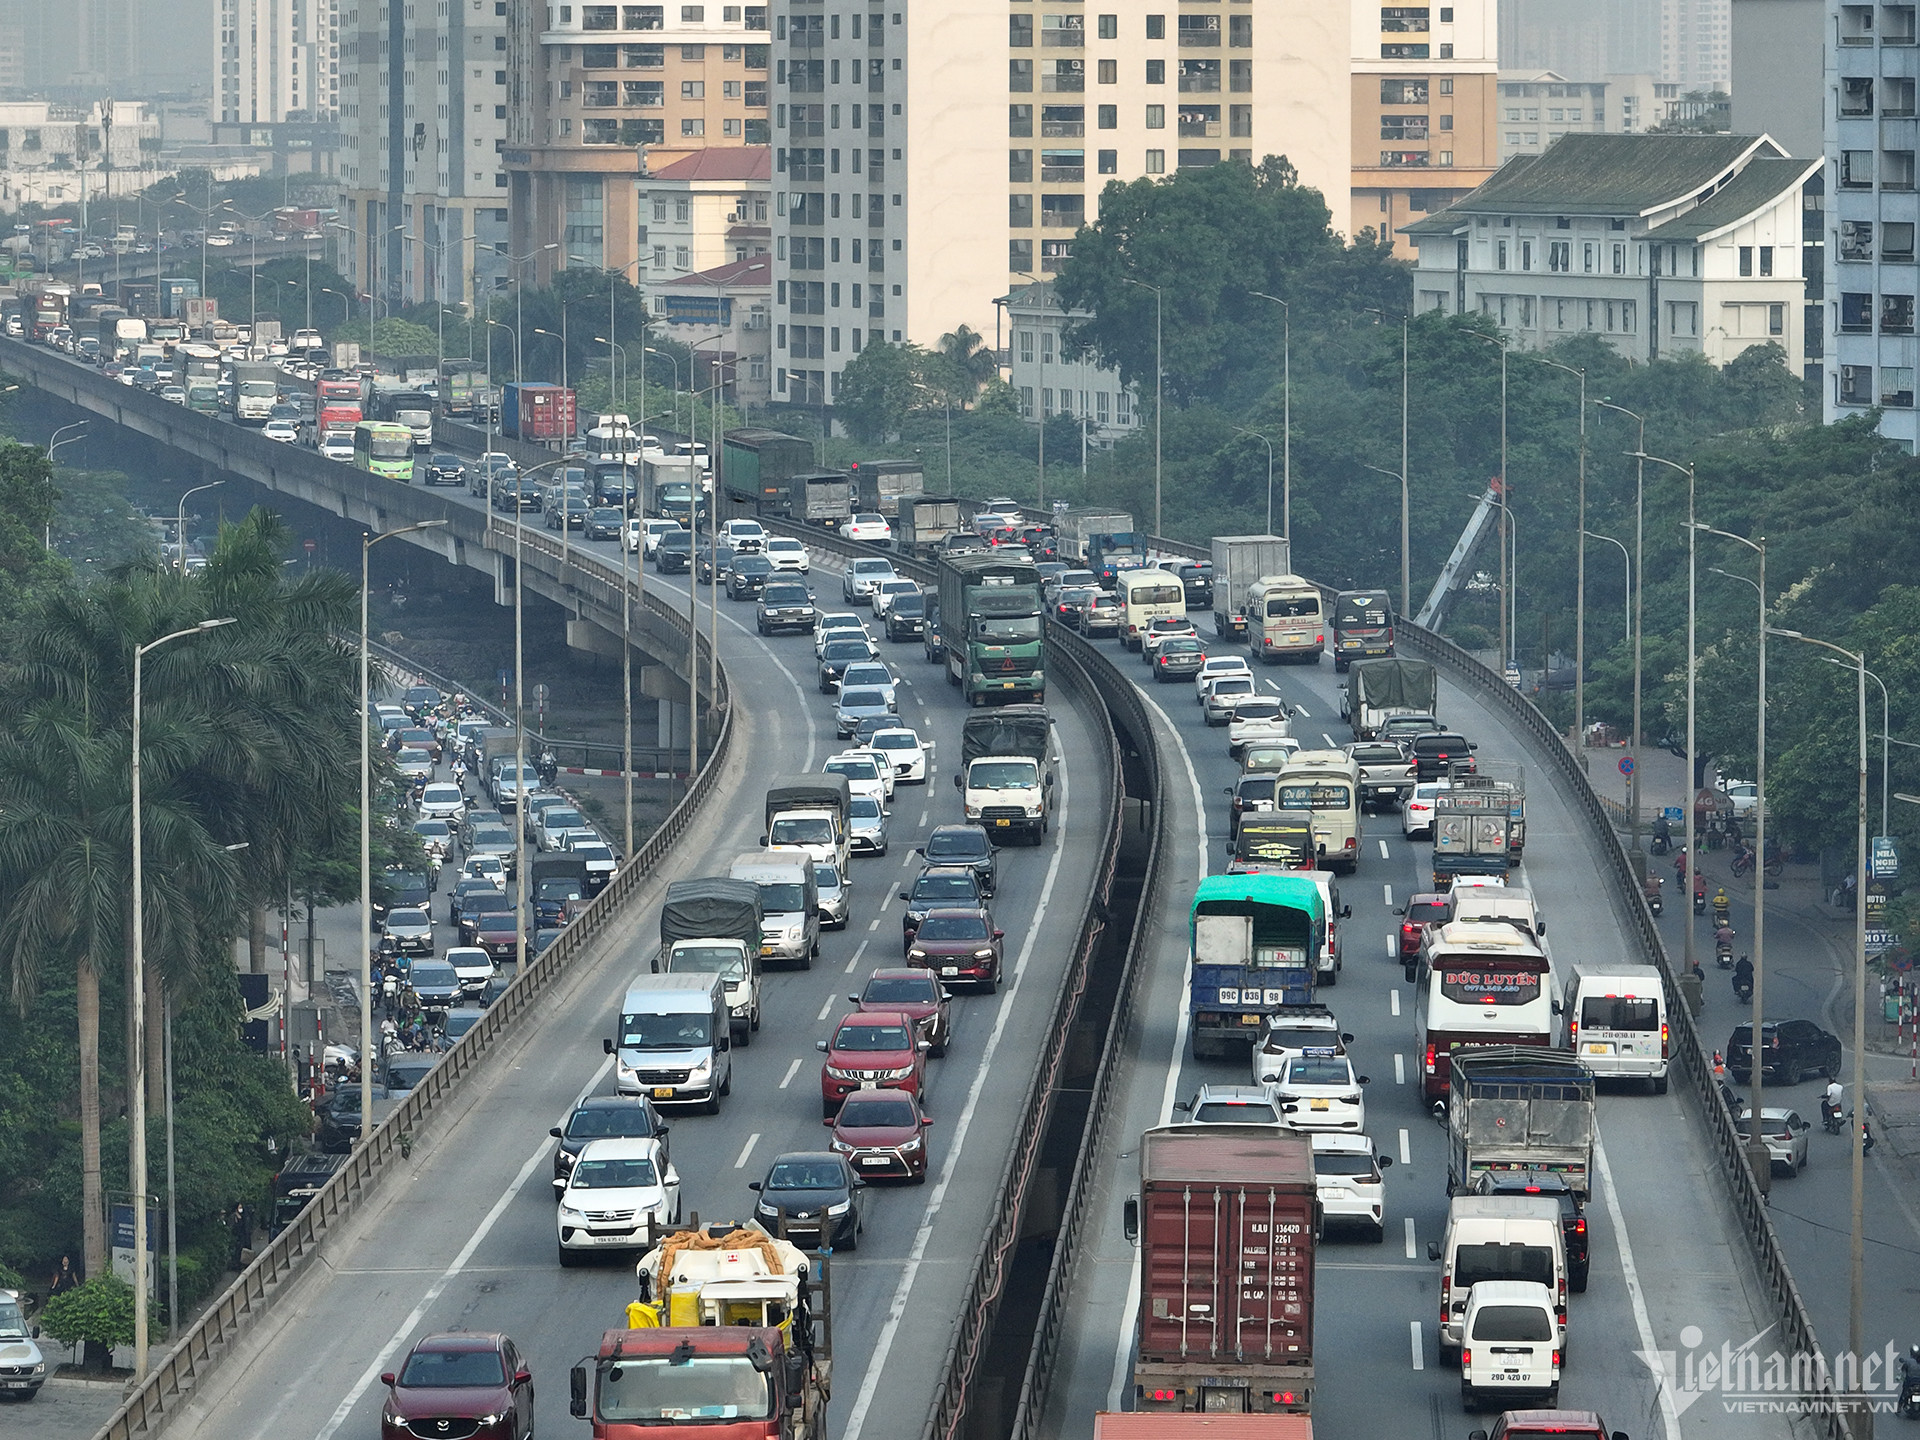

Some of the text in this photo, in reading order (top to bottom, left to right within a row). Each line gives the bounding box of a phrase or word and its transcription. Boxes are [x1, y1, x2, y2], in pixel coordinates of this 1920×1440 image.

[1446, 970, 1538, 986] ĐỨC LUYẾN
[1221, 991, 1279, 1001] 99C 036 98
[1276, 1224, 1300, 1234] 136420
